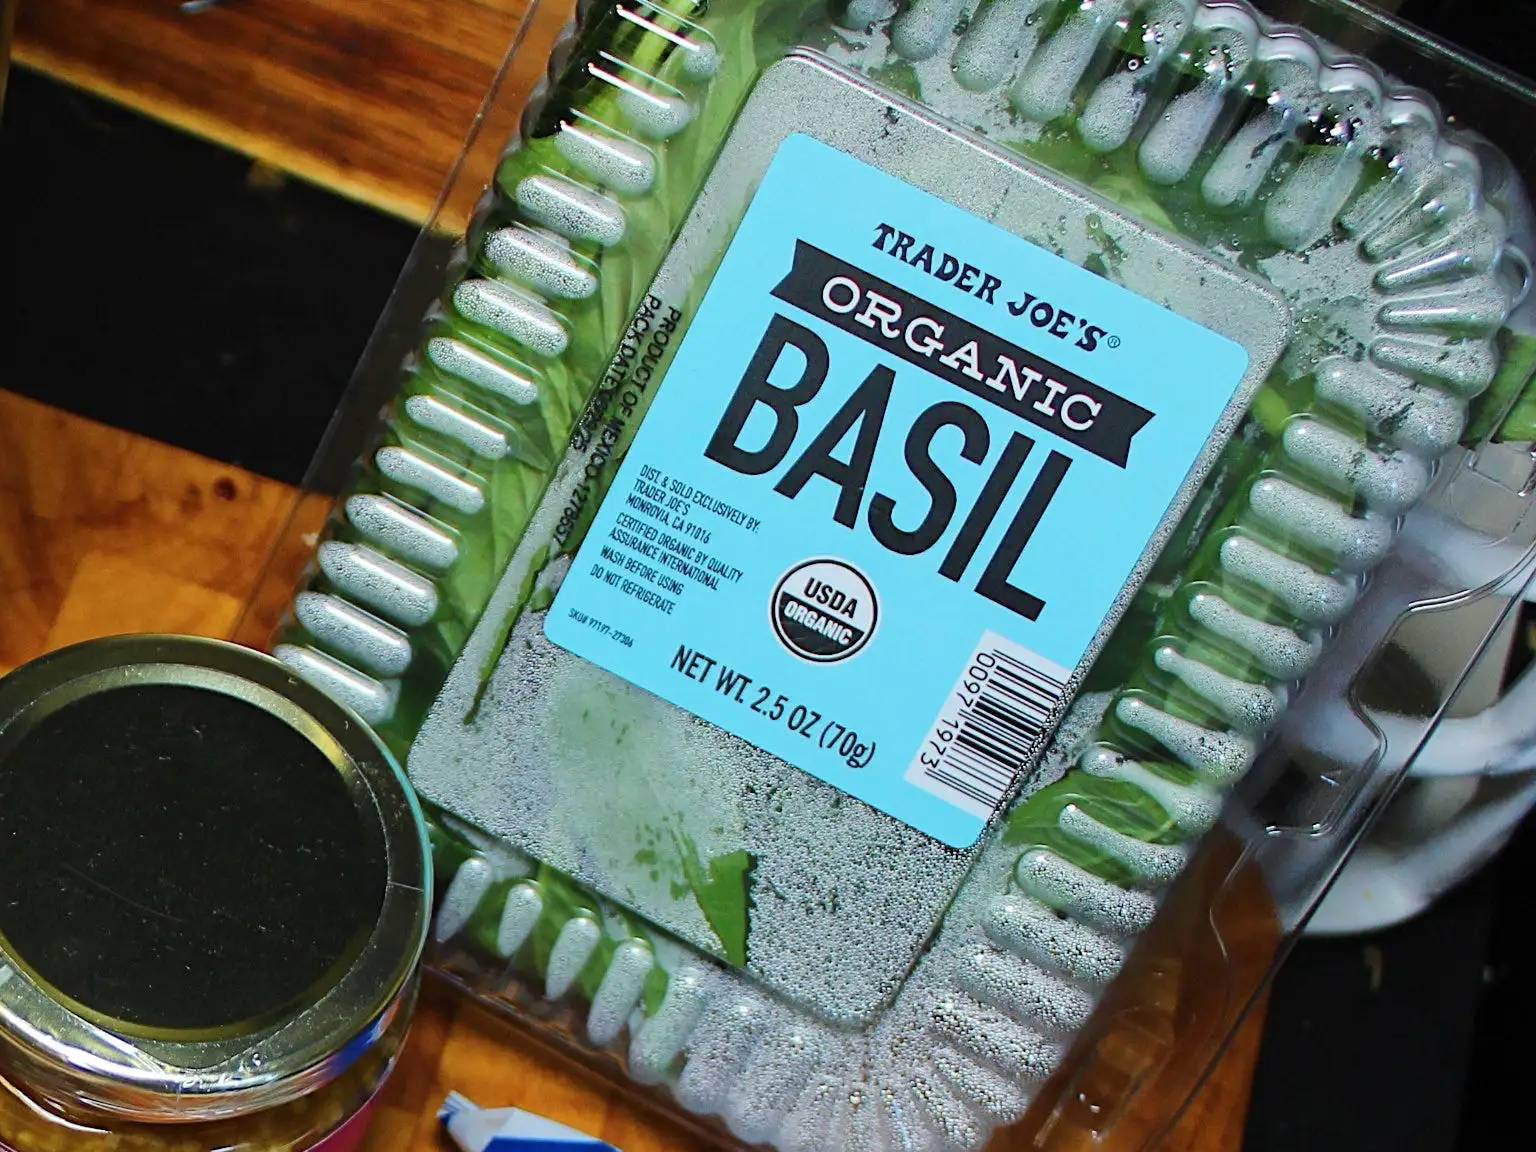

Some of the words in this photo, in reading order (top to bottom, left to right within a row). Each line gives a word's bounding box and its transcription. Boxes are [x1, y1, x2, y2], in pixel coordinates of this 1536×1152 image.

[872, 221, 1005, 304] TRADER
[627, 294, 662, 347] PACK
[636, 306, 682, 394] PRODUCT
[819, 276, 1103, 434] ORGANIC
[621, 389, 639, 419] OF
[704, 312, 1074, 622] BASIL
[625, 493, 670, 526] MONROVIA,
[672, 516, 685, 530] CA
[685, 522, 711, 544] 91016
[633, 478, 666, 504] TRADER
[665, 495, 691, 516] JOE'S
[669, 479, 693, 498] SOLD
[692, 491, 748, 526] EXCLUSIVELY
[600, 545, 624, 565] WASH
[624, 556, 658, 582] BEFORE
[657, 573, 685, 596] USING
[608, 527, 658, 561] ASSURANCE
[657, 551, 720, 591] INTERNATIONAL
[616, 512, 659, 543] CERTIFIED
[657, 533, 697, 561] ORGANIC
[694, 550, 708, 565] BY
[707, 558, 744, 584] QUALITY
[590, 563, 604, 580] DO
[603, 569, 622, 588] NOT
[620, 579, 676, 615] REFRIGERATE
[803, 577, 859, 619] USDA
[783, 600, 853, 645] ORGANIC
[956, 652, 996, 708] 0097
[670, 645, 717, 683] NET
[715, 666, 753, 703] WT.
[750, 686, 789, 720] 2.5
[787, 705, 822, 738] OZ
[818, 721, 876, 768] (70g)
[920, 718, 959, 769] 1973
